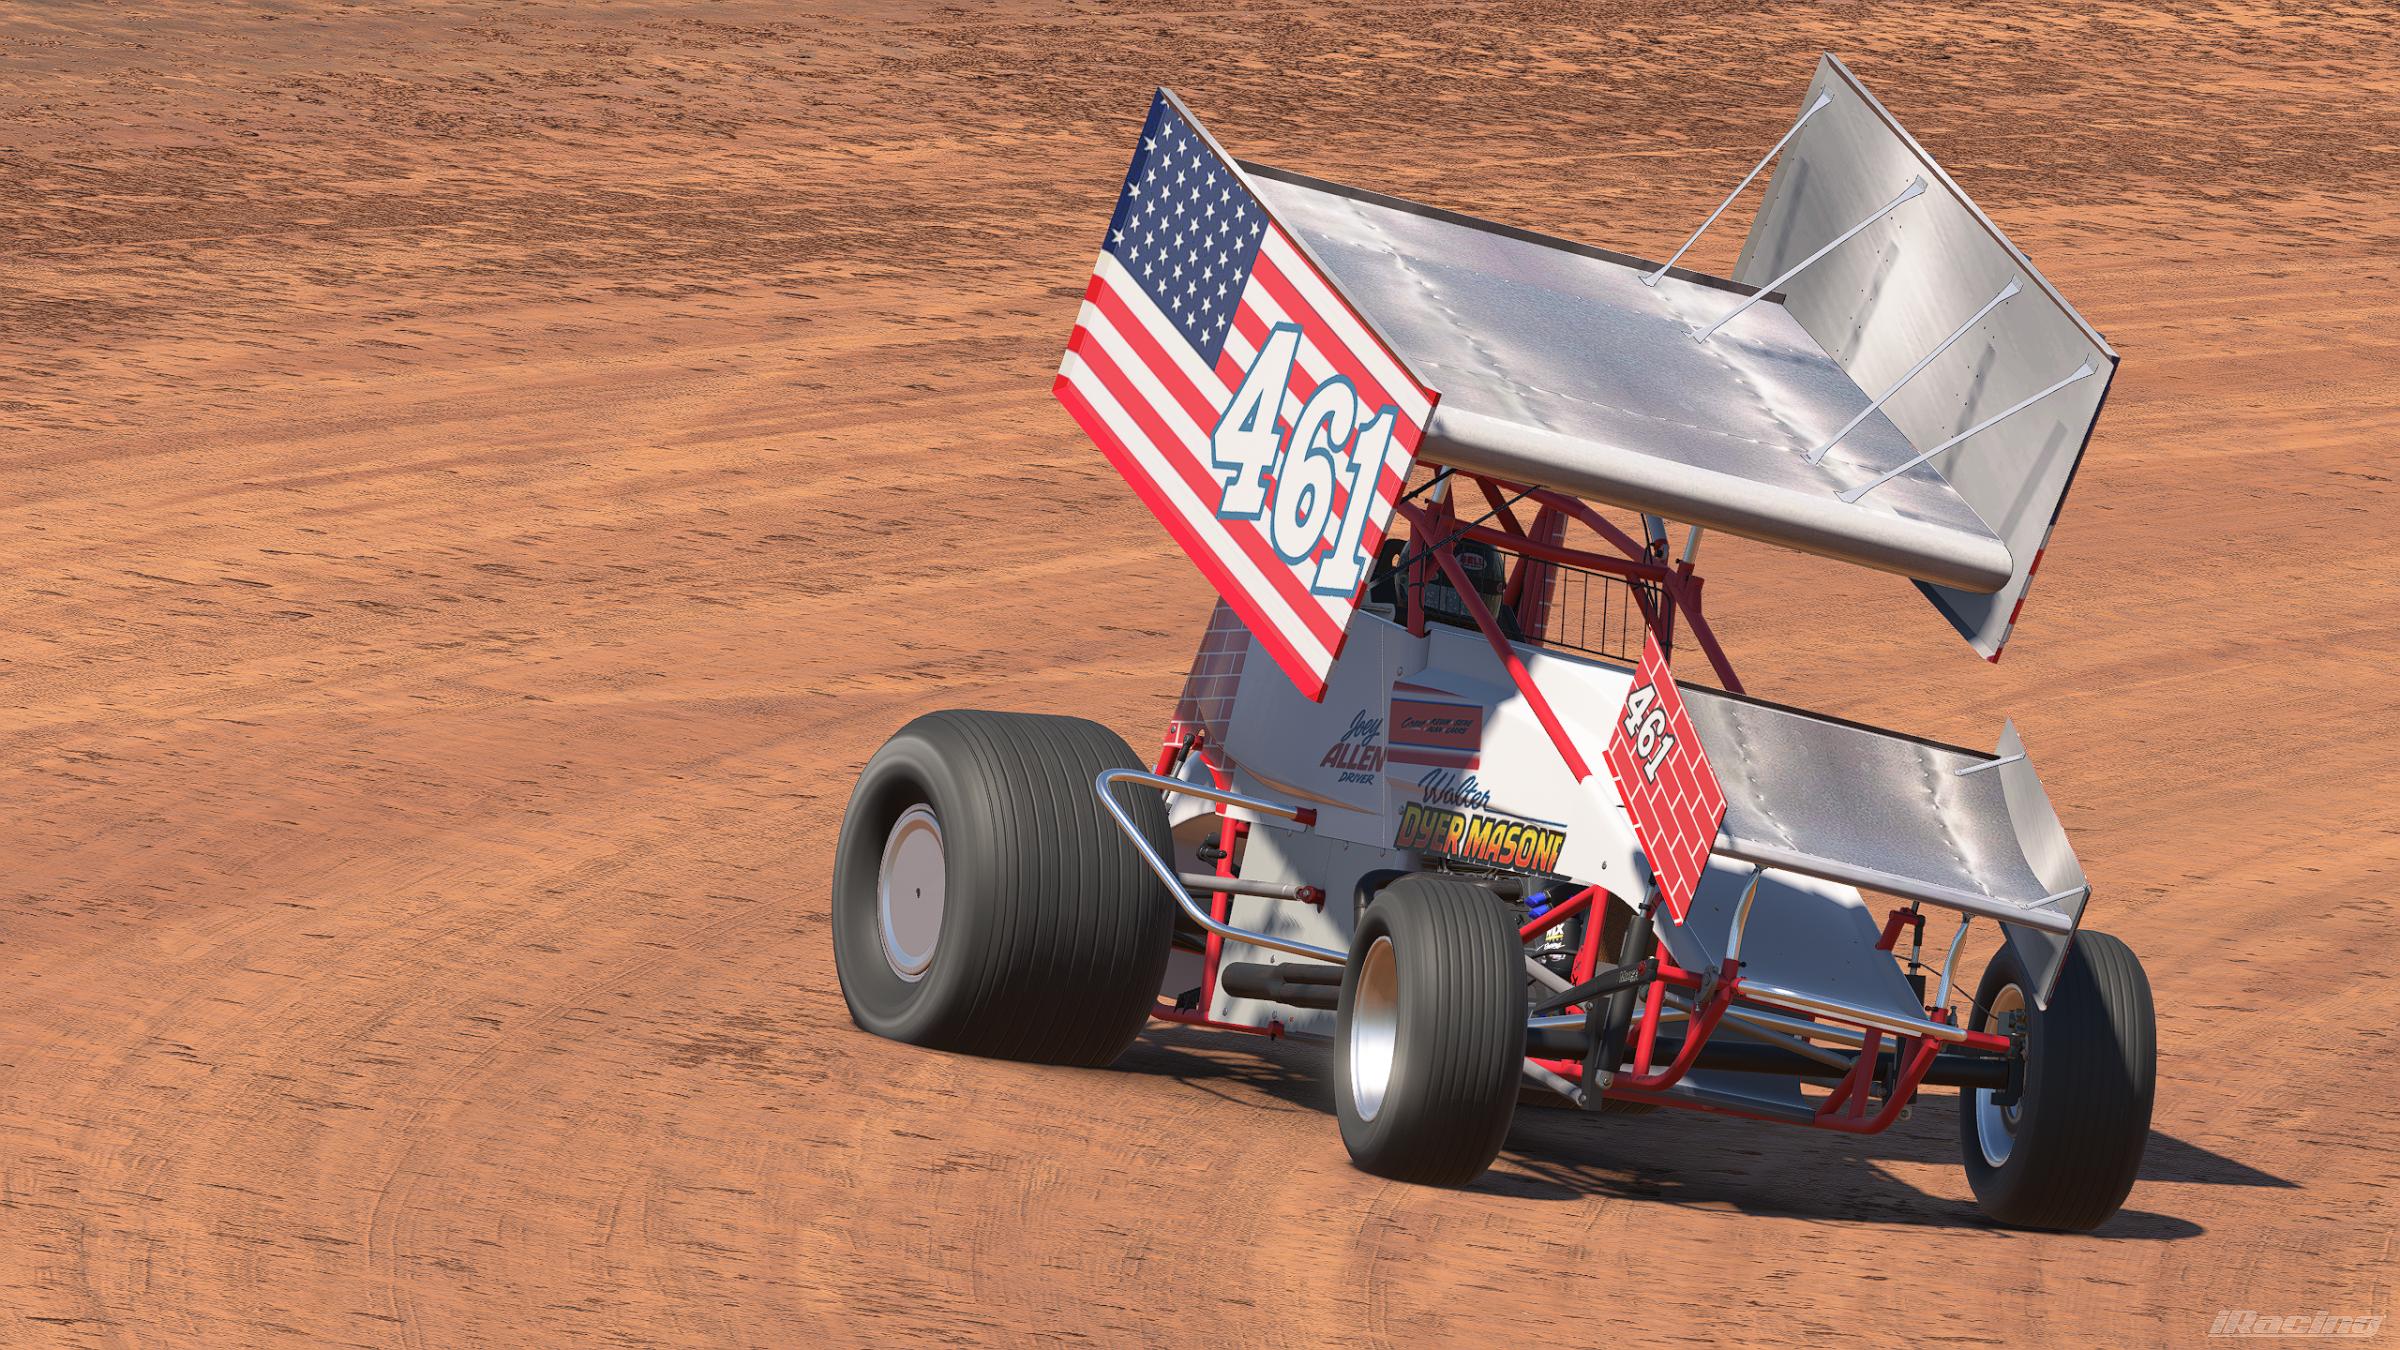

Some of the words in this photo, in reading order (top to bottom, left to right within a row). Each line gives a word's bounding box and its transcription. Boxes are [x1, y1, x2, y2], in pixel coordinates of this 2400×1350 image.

[1211, 321, 1399, 598] 461
[1341, 709, 1383, 746] Joey
[1623, 682, 1676, 785] 461
[1320, 743, 1387, 773] ALLEN
[1338, 771, 1375, 785] DRIVER
[1418, 768, 1492, 811] Walter
[1394, 801, 1466, 860] DYER
